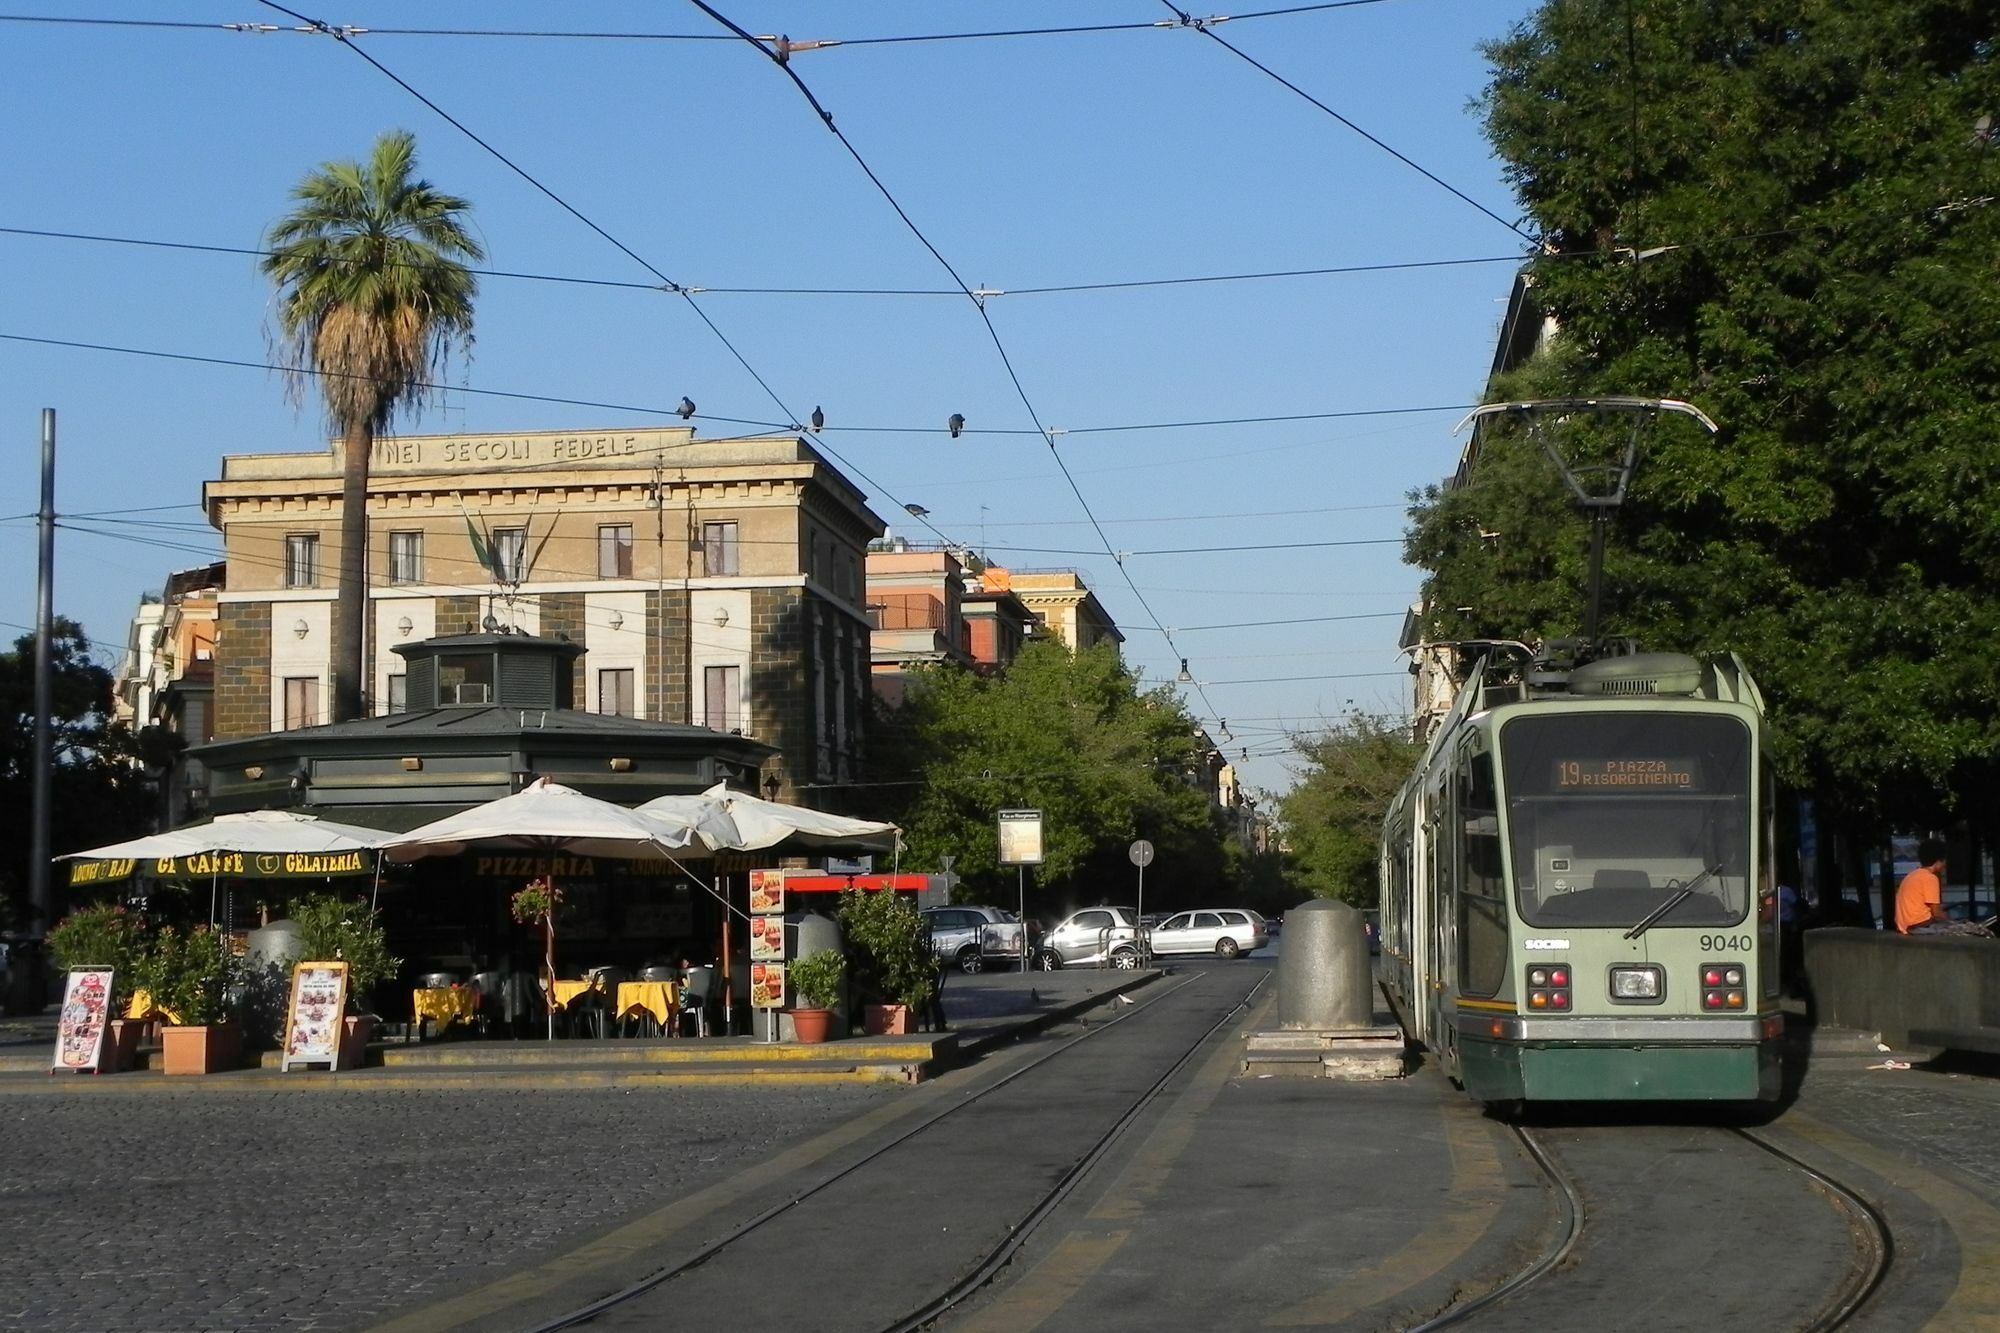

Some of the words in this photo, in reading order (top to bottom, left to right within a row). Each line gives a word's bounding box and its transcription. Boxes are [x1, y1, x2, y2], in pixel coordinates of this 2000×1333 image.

[386, 442, 421, 464] NEI
[443, 439, 530, 462] SECOLI
[552, 437, 636, 458] FEDELE
[1560, 761, 1580, 785] 19
[1607, 761, 1667, 773] PIAZZA
[1582, 773, 1690, 785] RISORGIMENTO
[285, 852, 362, 873] GELATERIA
[477, 857, 595, 876] PIZZERIA
[712, 853, 770, 873] PZZERIA
[1700, 935, 1752, 951] 9040
